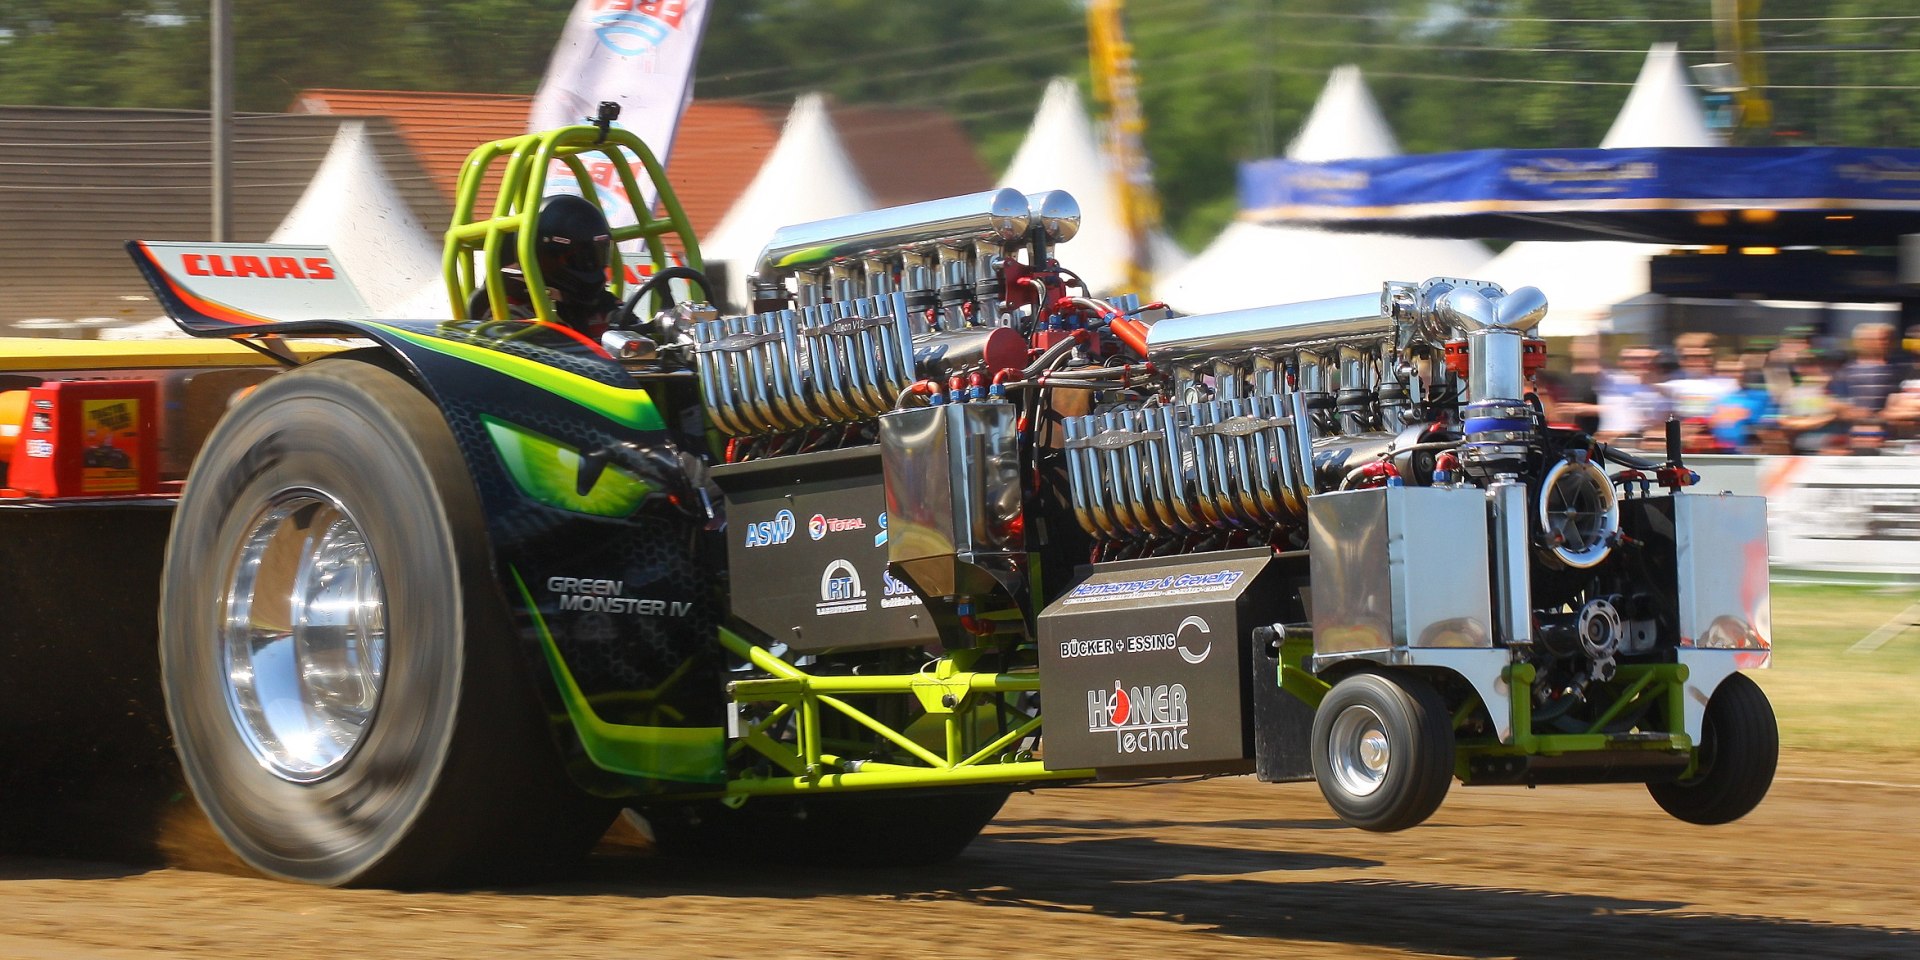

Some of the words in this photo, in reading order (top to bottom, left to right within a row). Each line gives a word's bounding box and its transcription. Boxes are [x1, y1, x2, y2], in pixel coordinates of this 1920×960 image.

[181, 253, 336, 280] CLAAS
[827, 517, 866, 532] TOTAL
[547, 576, 623, 596] GREEN
[828, 577, 853, 600] RT
[1159, 576, 1174, 590] &
[559, 594, 667, 616] MONSTER
[669, 601, 693, 617] IV
[1060, 638, 1114, 658] BÜCKER
[1115, 640, 1125, 651] +
[1127, 633, 1176, 653] ESSING
